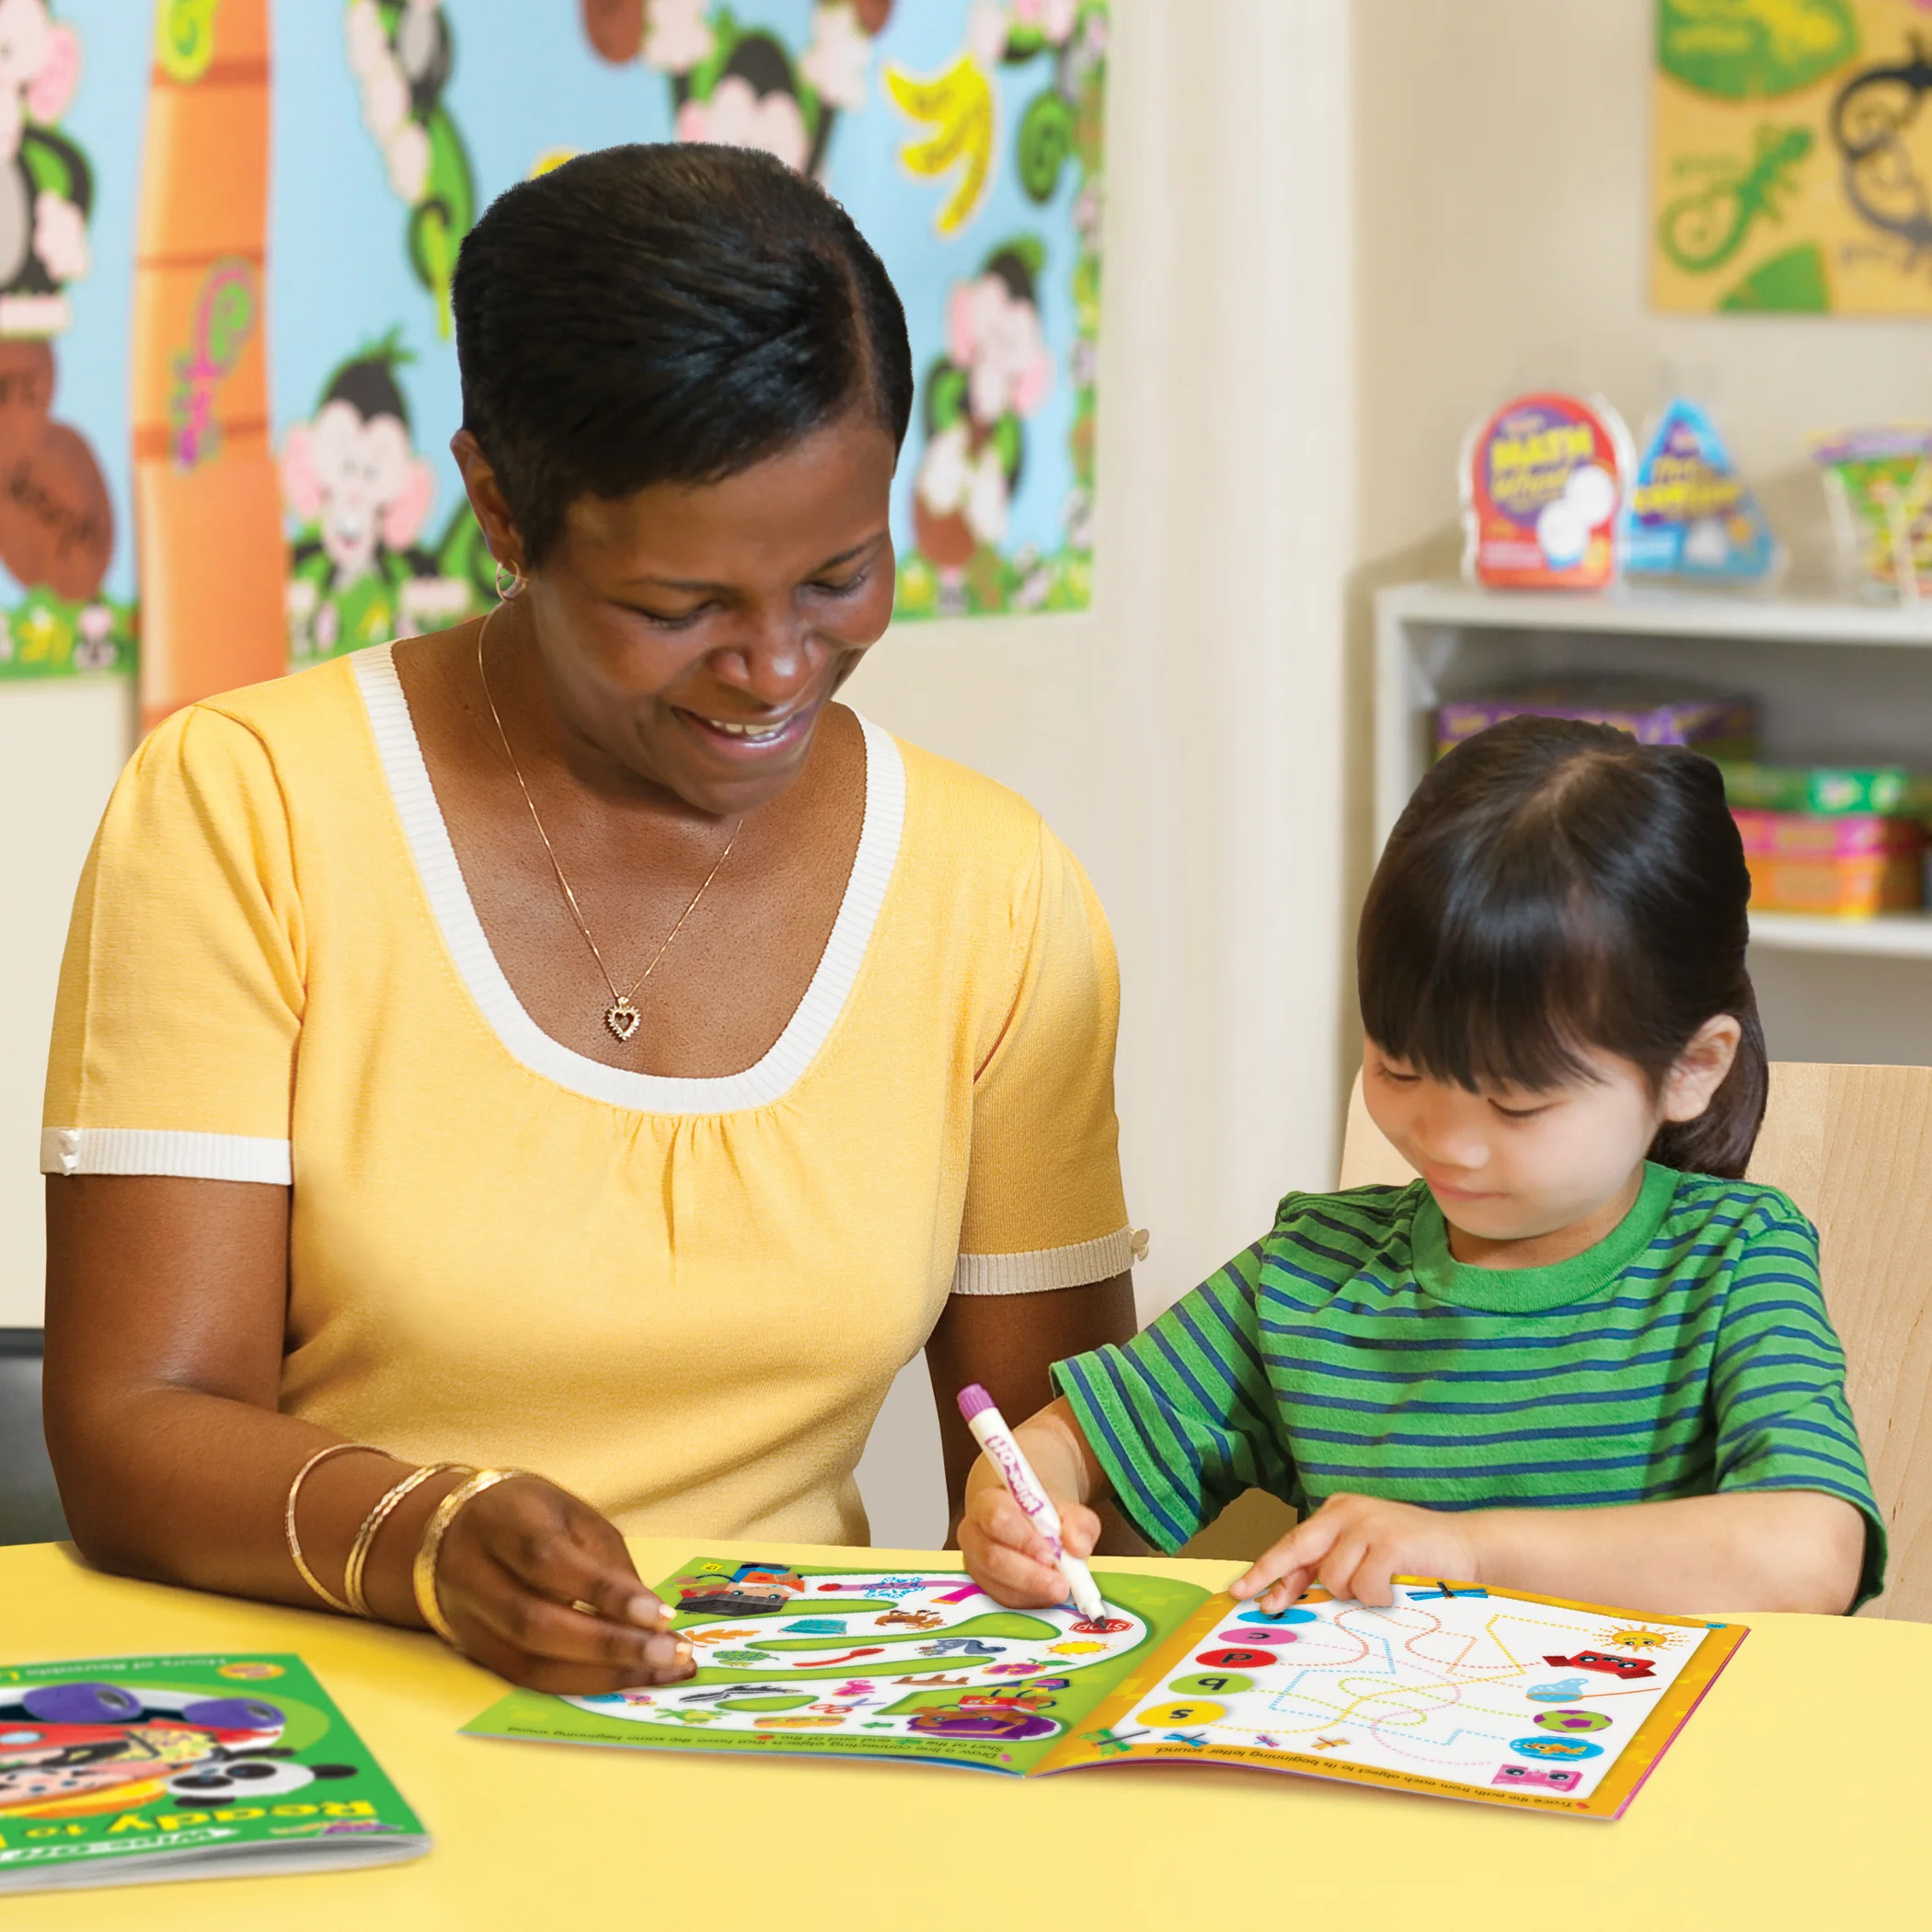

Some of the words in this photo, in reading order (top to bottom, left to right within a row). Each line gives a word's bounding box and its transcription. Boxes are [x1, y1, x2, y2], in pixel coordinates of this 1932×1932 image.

[1220, 1652, 1253, 1663] d
[1197, 1677, 1229, 1691] b
[1169, 1708, 1194, 1719] s
[553, 1731, 623, 1741] beginning
[830, 1741, 912, 1750] connecting
[971, 1744, 1006, 1754] Start
[1155, 1746, 1204, 1755] sound.
[959, 1749, 998, 1760] Draw
[1208, 1747, 1246, 1757] letter
[1249, 1751, 1319, 1766] beginning
[1358, 1768, 1400, 1779] object
[1404, 1777, 1436, 1787] each
[1441, 1783, 1470, 1793] from
[1475, 1789, 1505, 1798] path
[1534, 1799, 1572, 1808] Trace
[106, 1800, 377, 1833] Ready
[24, 1823, 88, 1837] to
